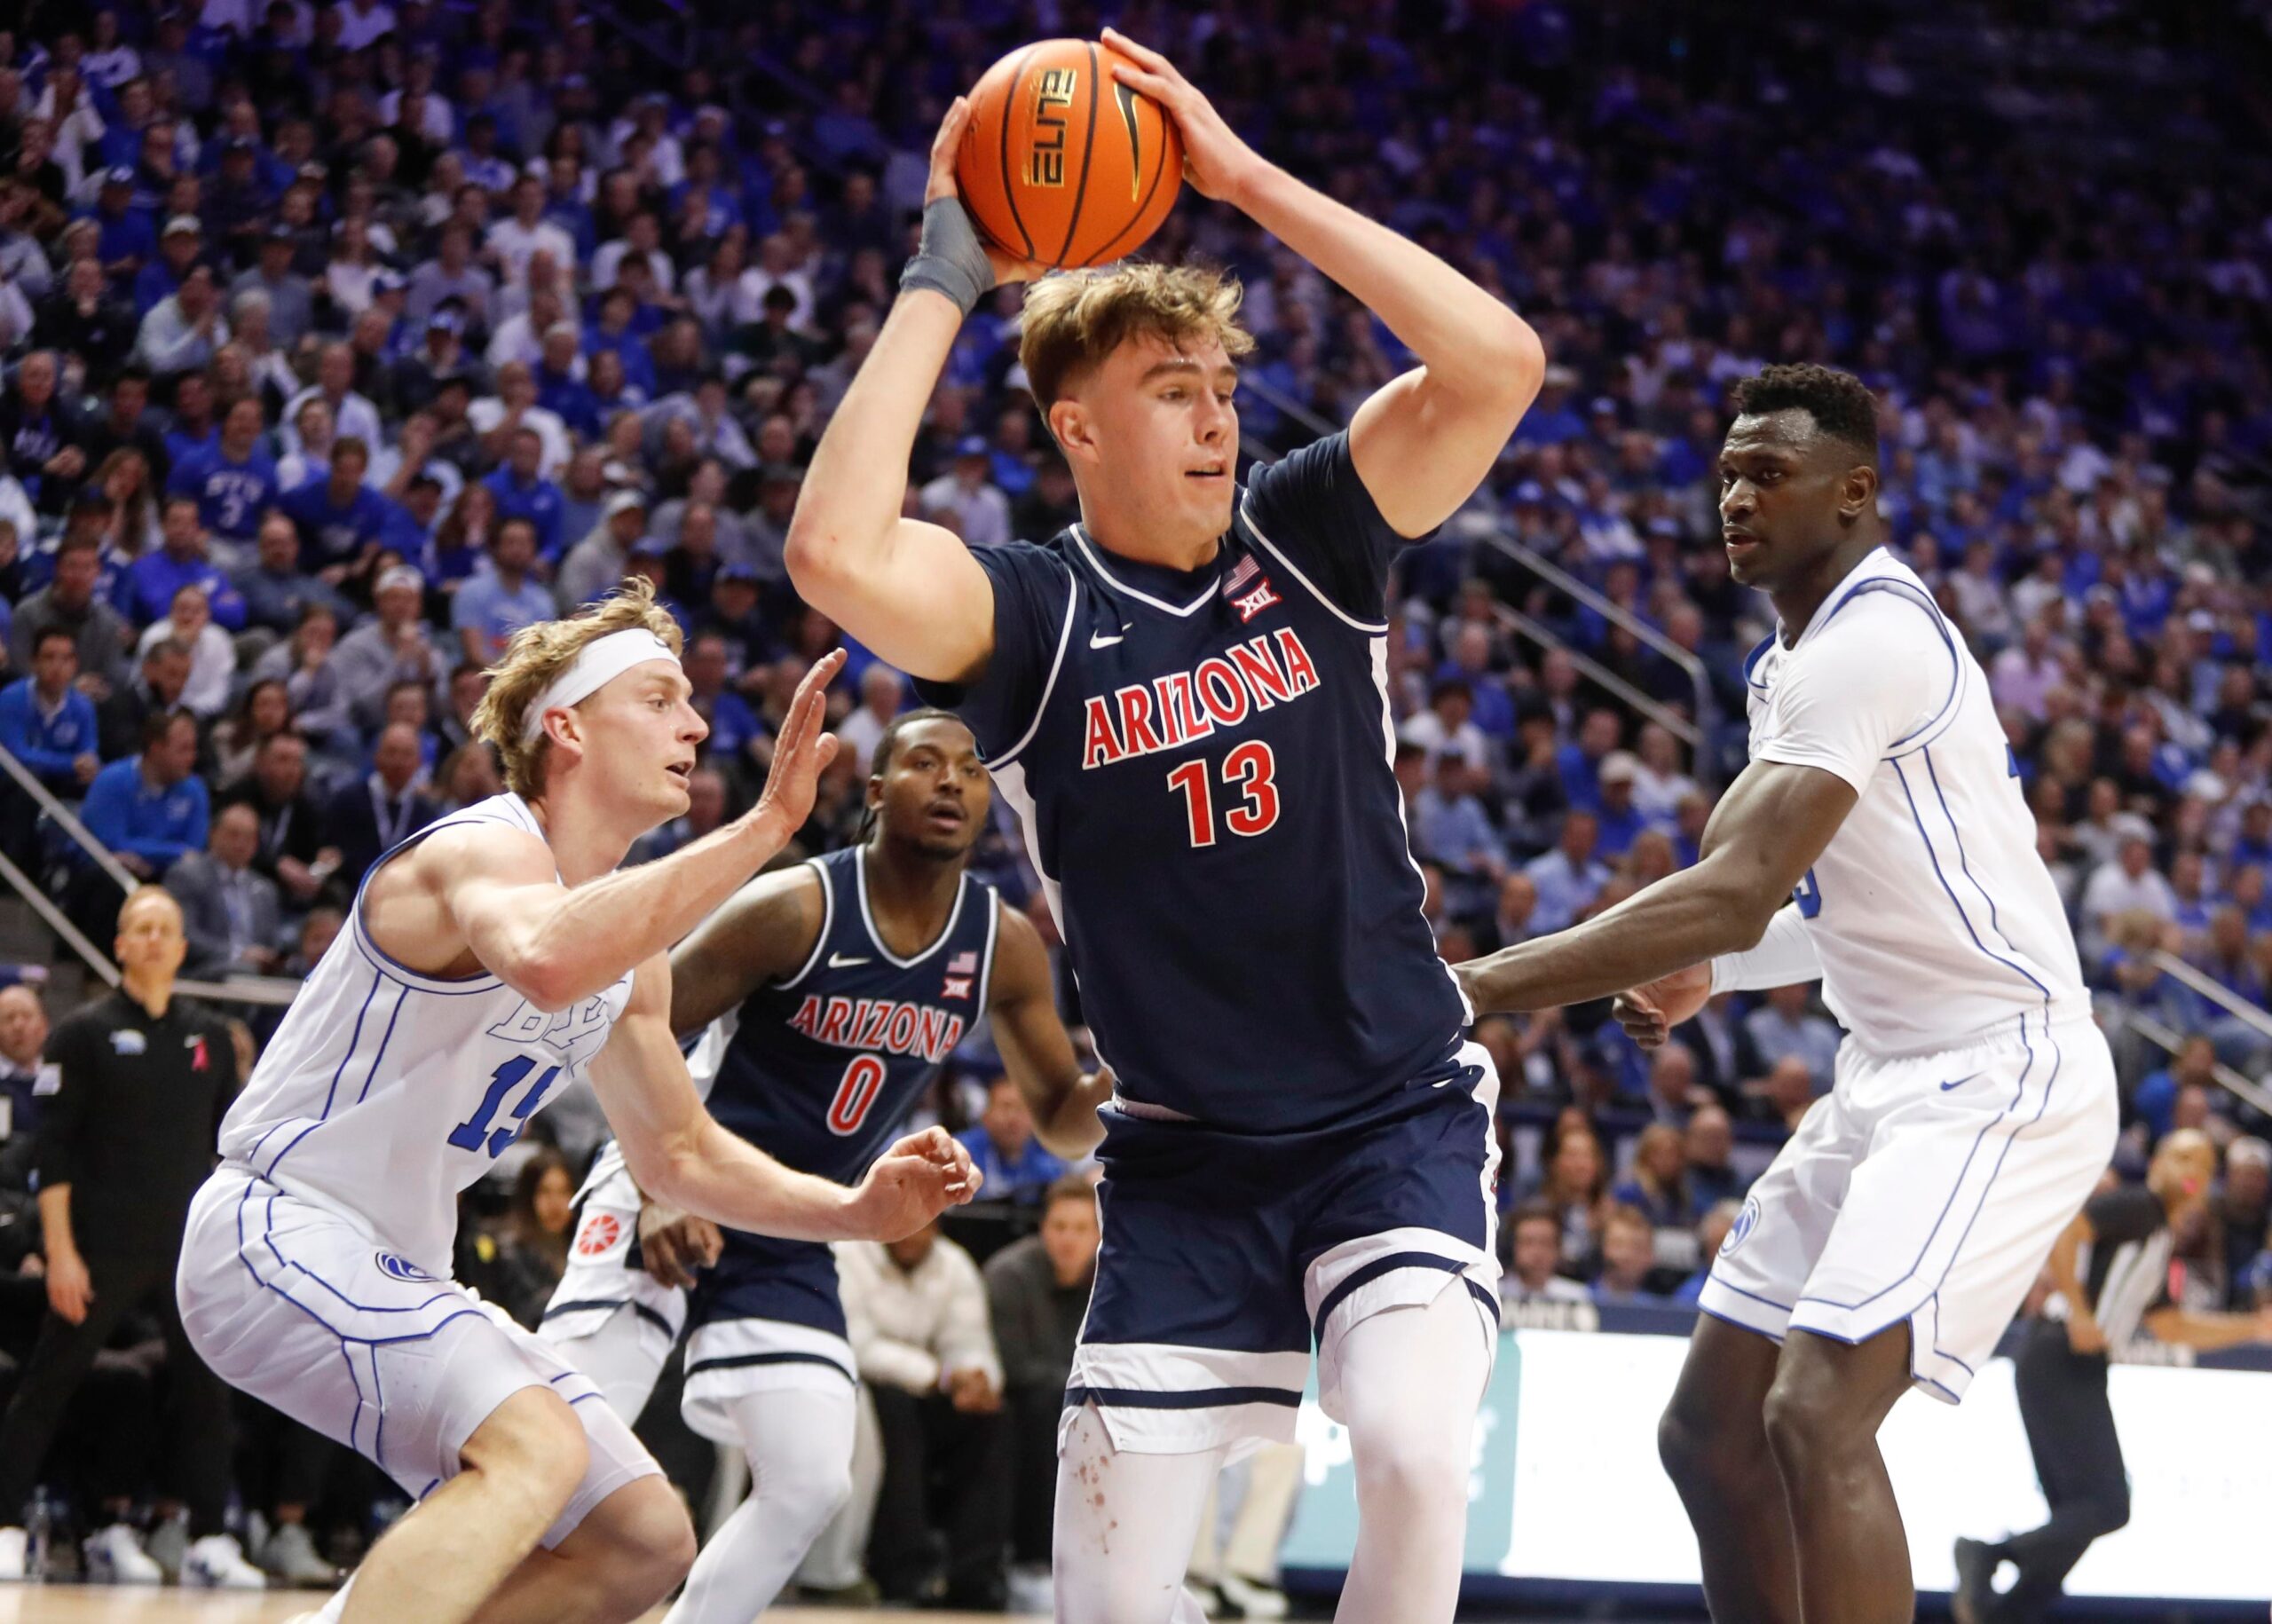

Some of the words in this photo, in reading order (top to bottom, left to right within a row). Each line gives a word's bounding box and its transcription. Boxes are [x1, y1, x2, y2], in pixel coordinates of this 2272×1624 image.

[1031, 67, 1077, 187] ELITE
[1231, 579, 1282, 624] XII
[1082, 627, 1321, 770] ARIZONA
[1167, 739, 1280, 848] 13
[786, 995, 964, 1064] ARIZONA
[826, 1053, 886, 1137] 0
